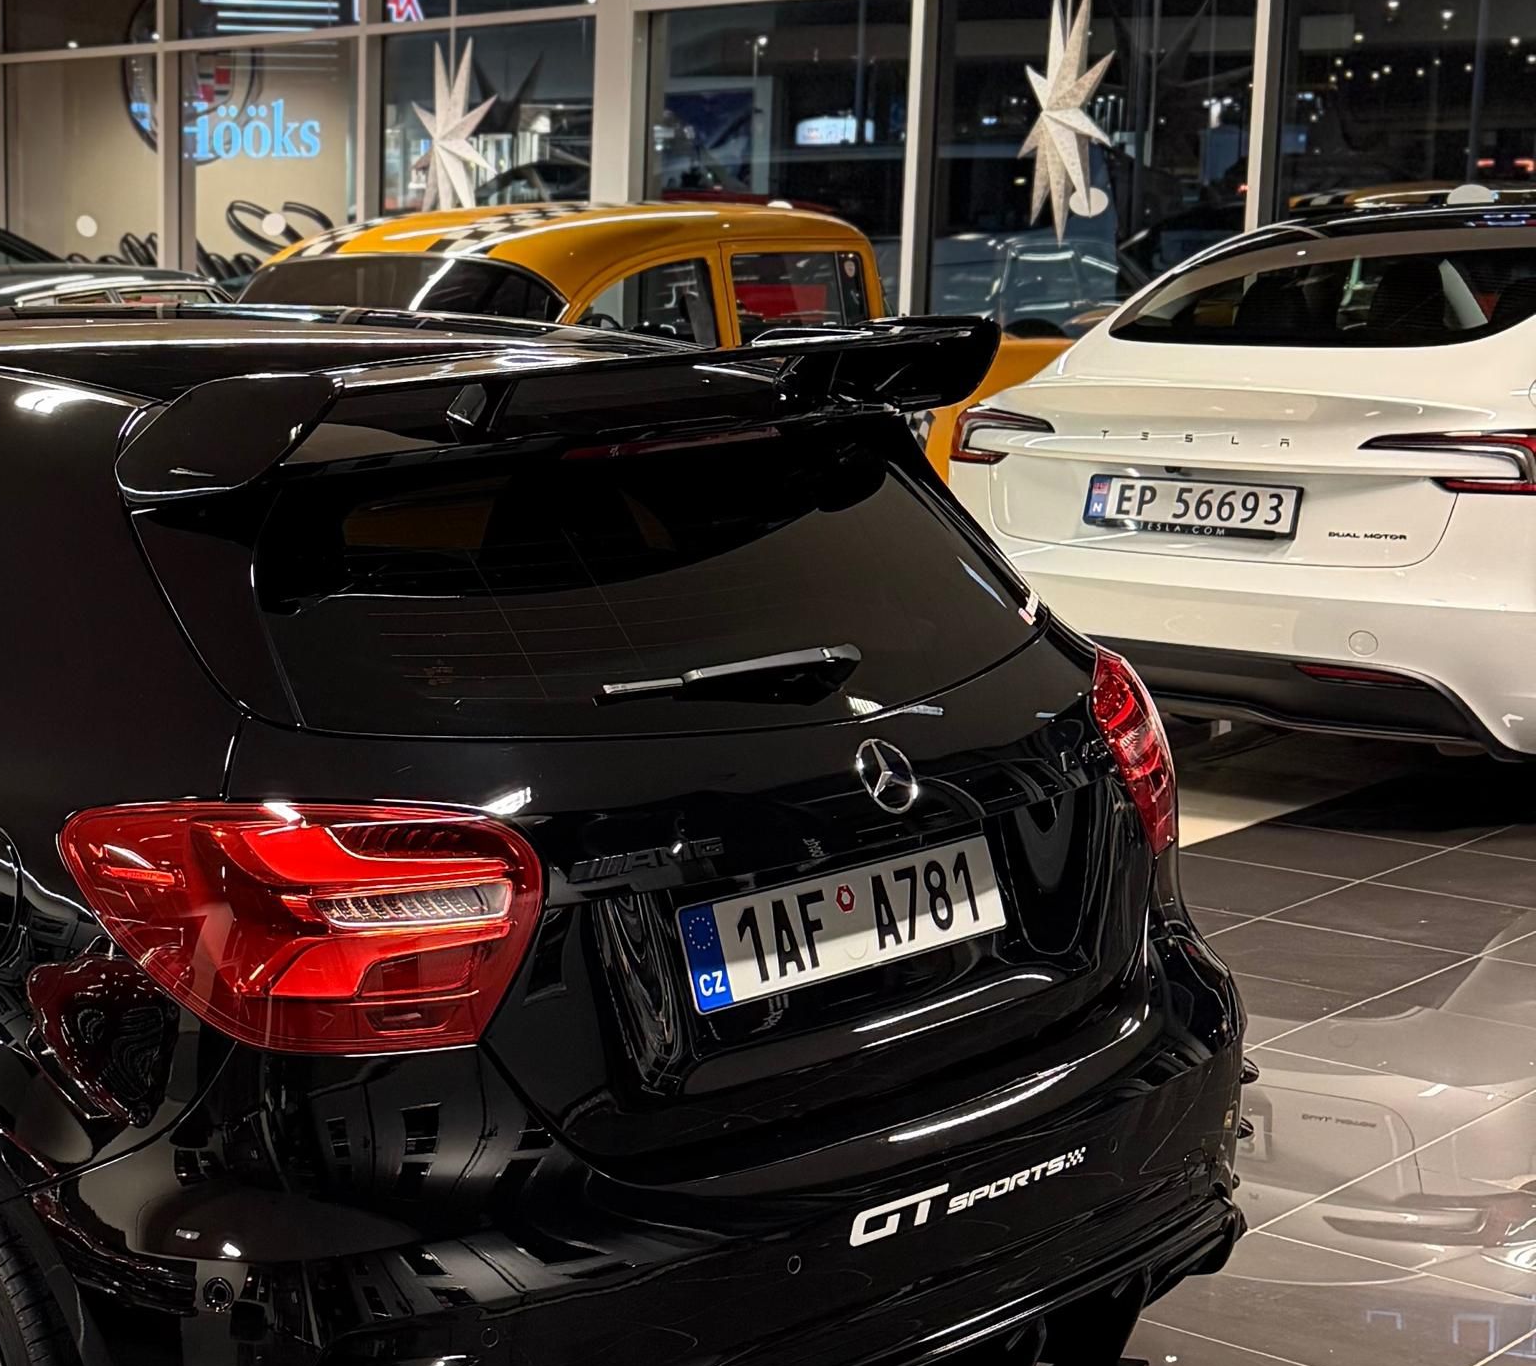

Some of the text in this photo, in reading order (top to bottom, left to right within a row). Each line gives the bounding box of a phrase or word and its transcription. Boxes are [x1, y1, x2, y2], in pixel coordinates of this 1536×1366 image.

[1101, 430, 1290, 447] TESLA
[1092, 502, 1103, 514] N
[1115, 483, 1284, 525] EP 56693
[1328, 531, 1408, 541] DUAL MOTOR
[736, 850, 981, 984] 1AF A781
[698, 970, 727, 997] CZ
[849, 1153, 1066, 1247] GT SPORTS
